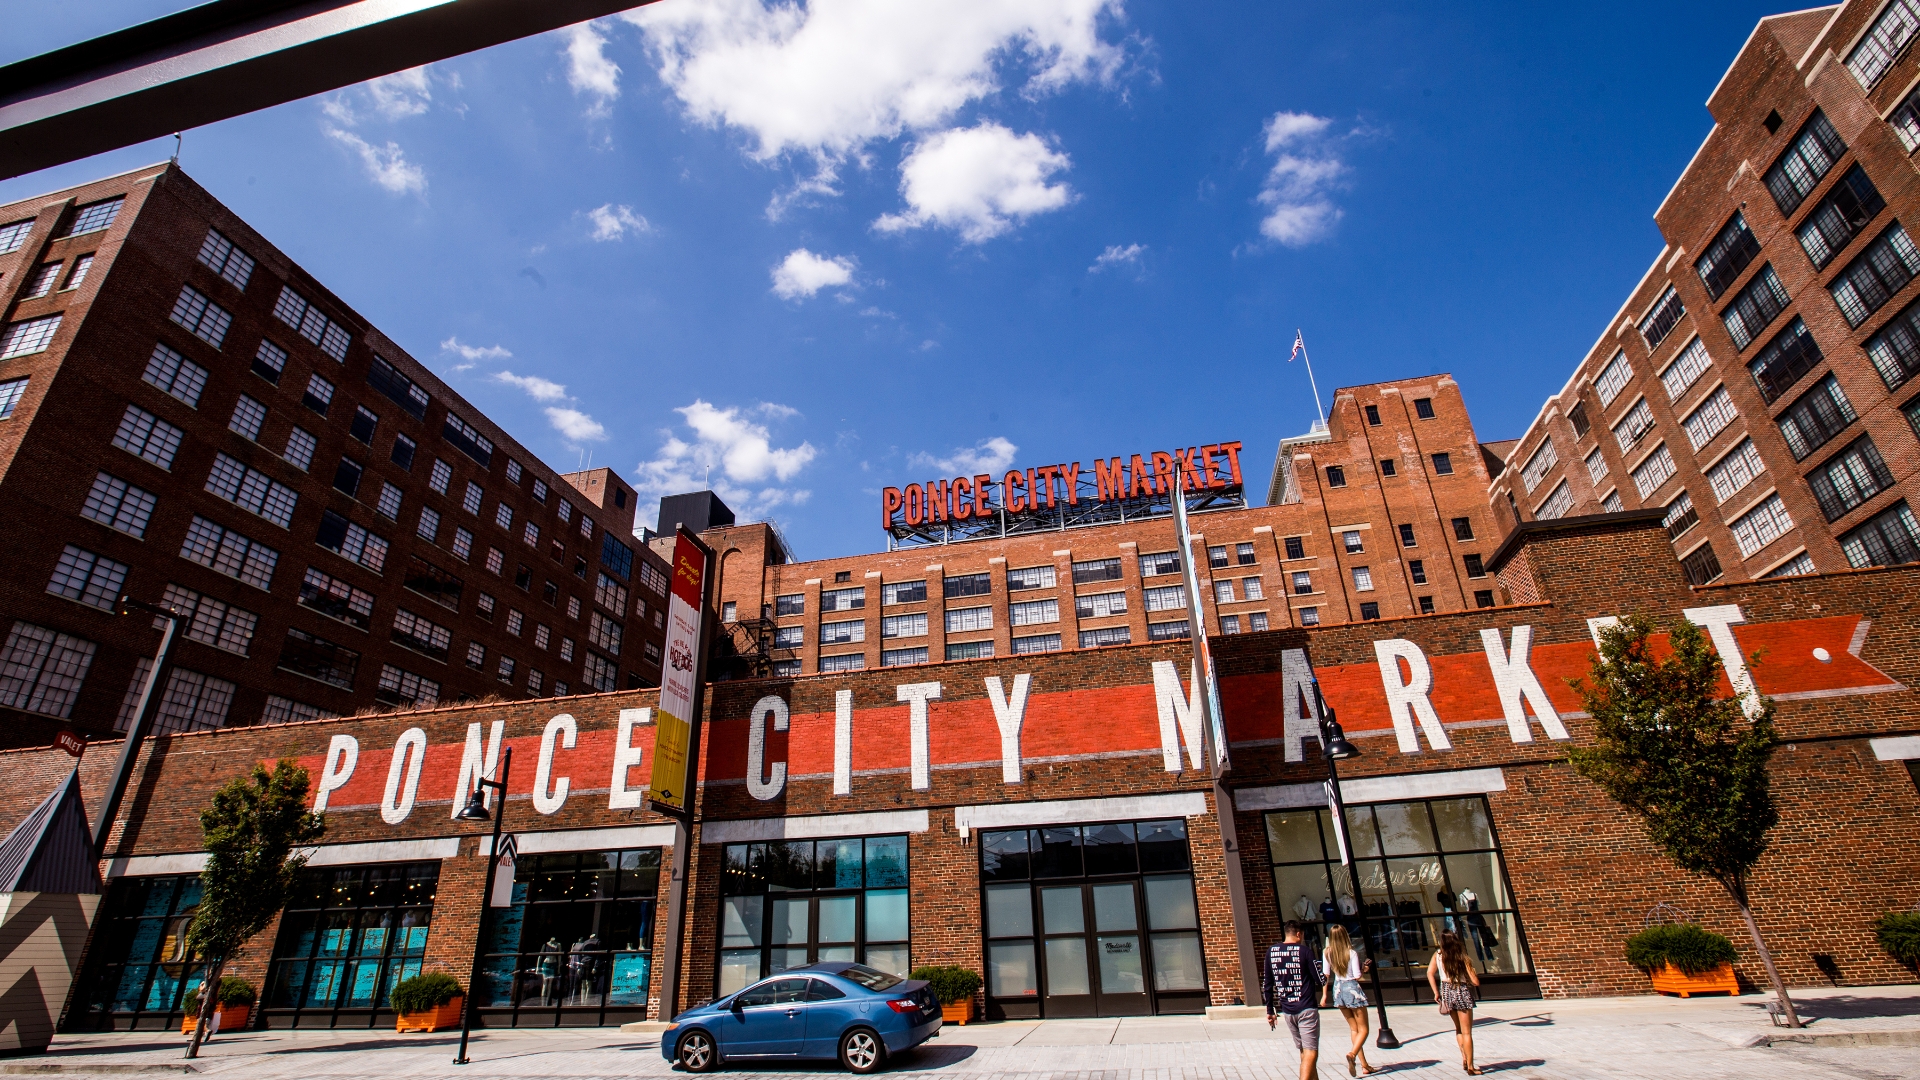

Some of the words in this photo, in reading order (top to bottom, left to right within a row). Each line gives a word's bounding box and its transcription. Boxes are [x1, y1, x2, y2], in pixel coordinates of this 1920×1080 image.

[882, 474, 993, 531] PONCE
[1004, 461, 1081, 516] CITY
[1094, 441, 1244, 504] MARKET
[60, 734, 82, 752] VALET
[314, 707, 652, 824] PONCE
[746, 673, 1032, 801] CITY
[500, 857, 512, 867] VALET
